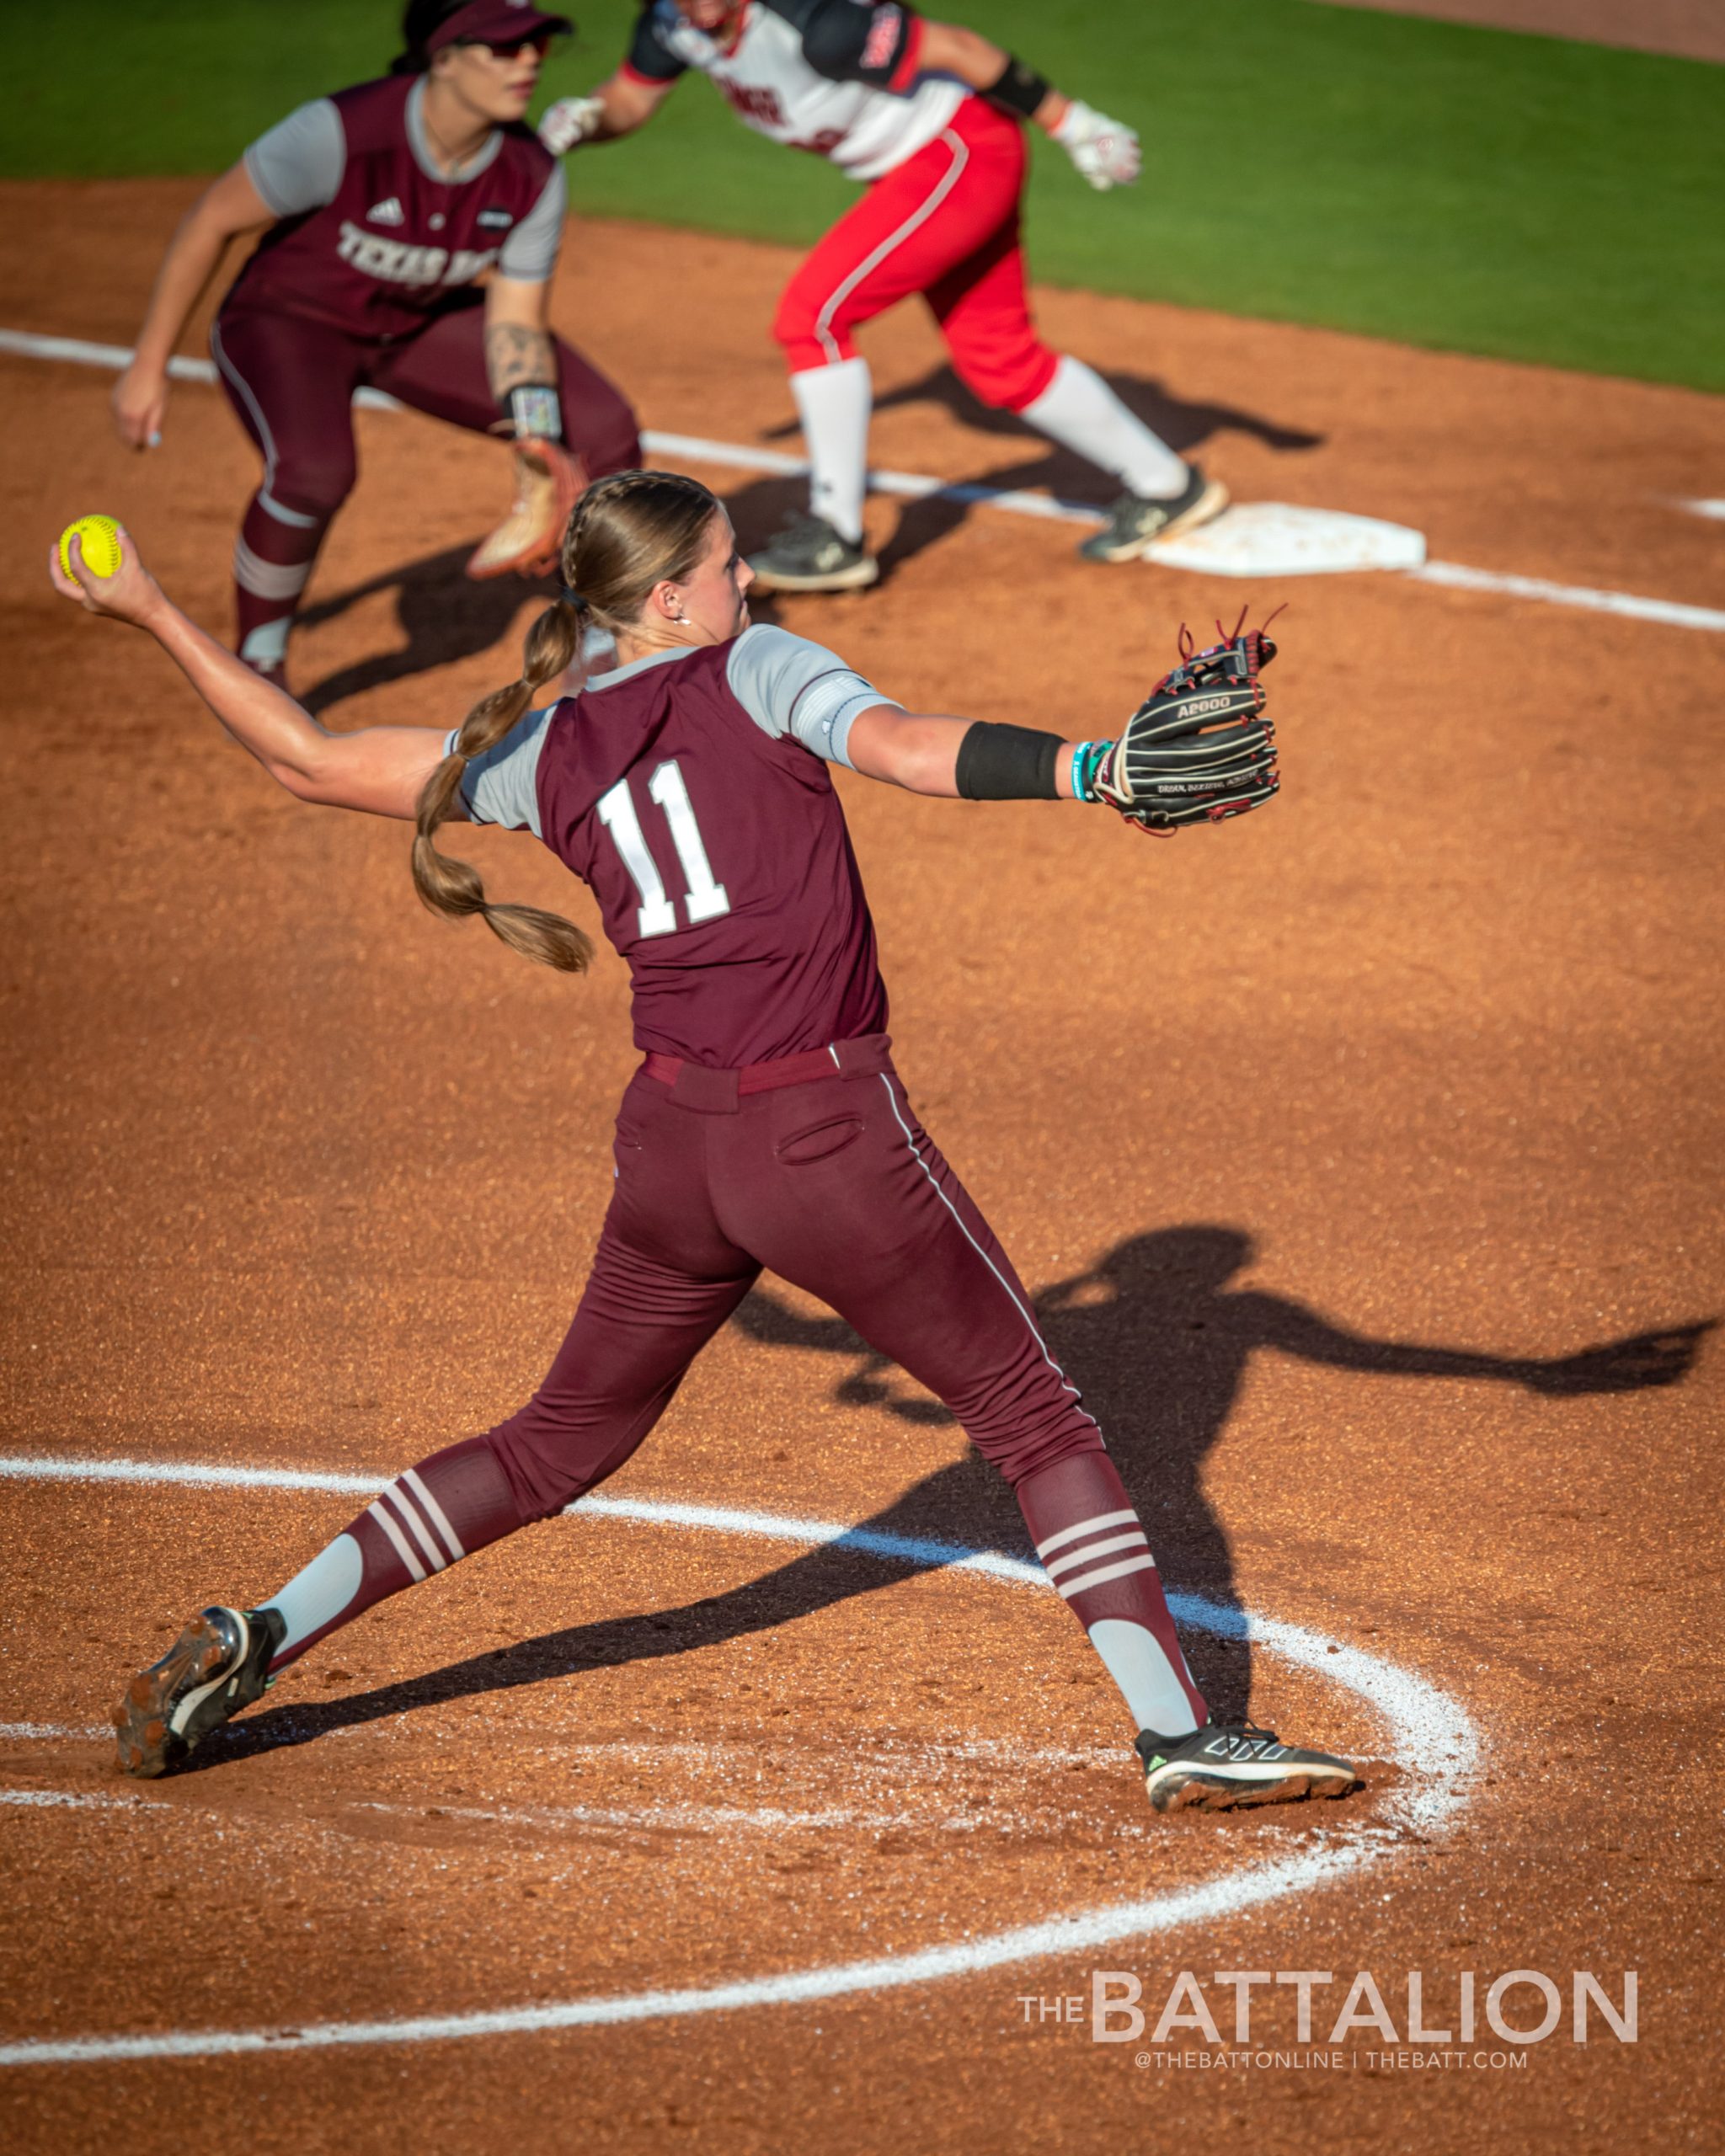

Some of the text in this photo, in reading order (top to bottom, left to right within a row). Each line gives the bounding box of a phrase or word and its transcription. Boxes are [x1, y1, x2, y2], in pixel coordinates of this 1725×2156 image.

[338, 220, 448, 286] TEXAS
[1178, 696, 1231, 718] A2000
[595, 759, 731, 938] 11
